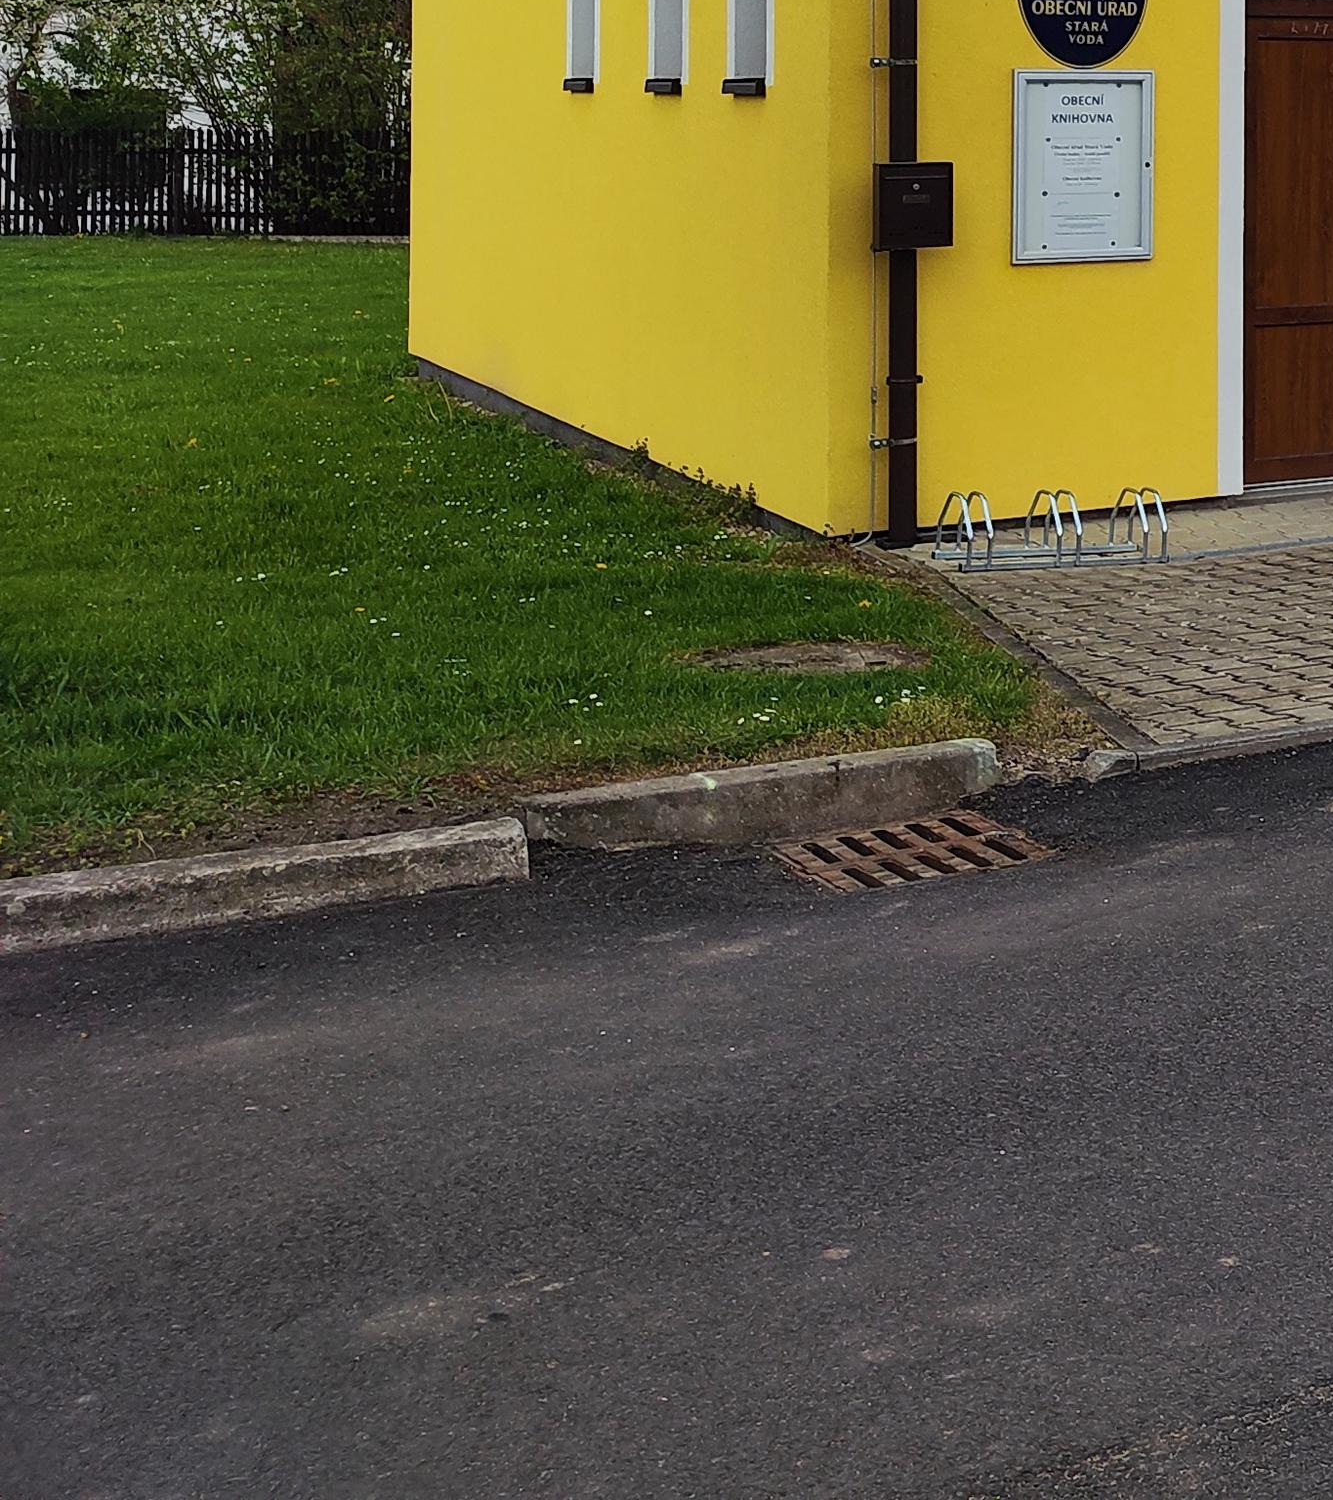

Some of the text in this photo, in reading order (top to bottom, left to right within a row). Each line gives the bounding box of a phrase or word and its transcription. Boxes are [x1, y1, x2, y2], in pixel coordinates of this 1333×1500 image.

[1065, 20, 1109, 32] STARÁ
[1068, 34, 1104, 45] VODA
[1061, 94, 1104, 106] OBECNÍ
[1051, 113, 1114, 124] KNIHOVNA
